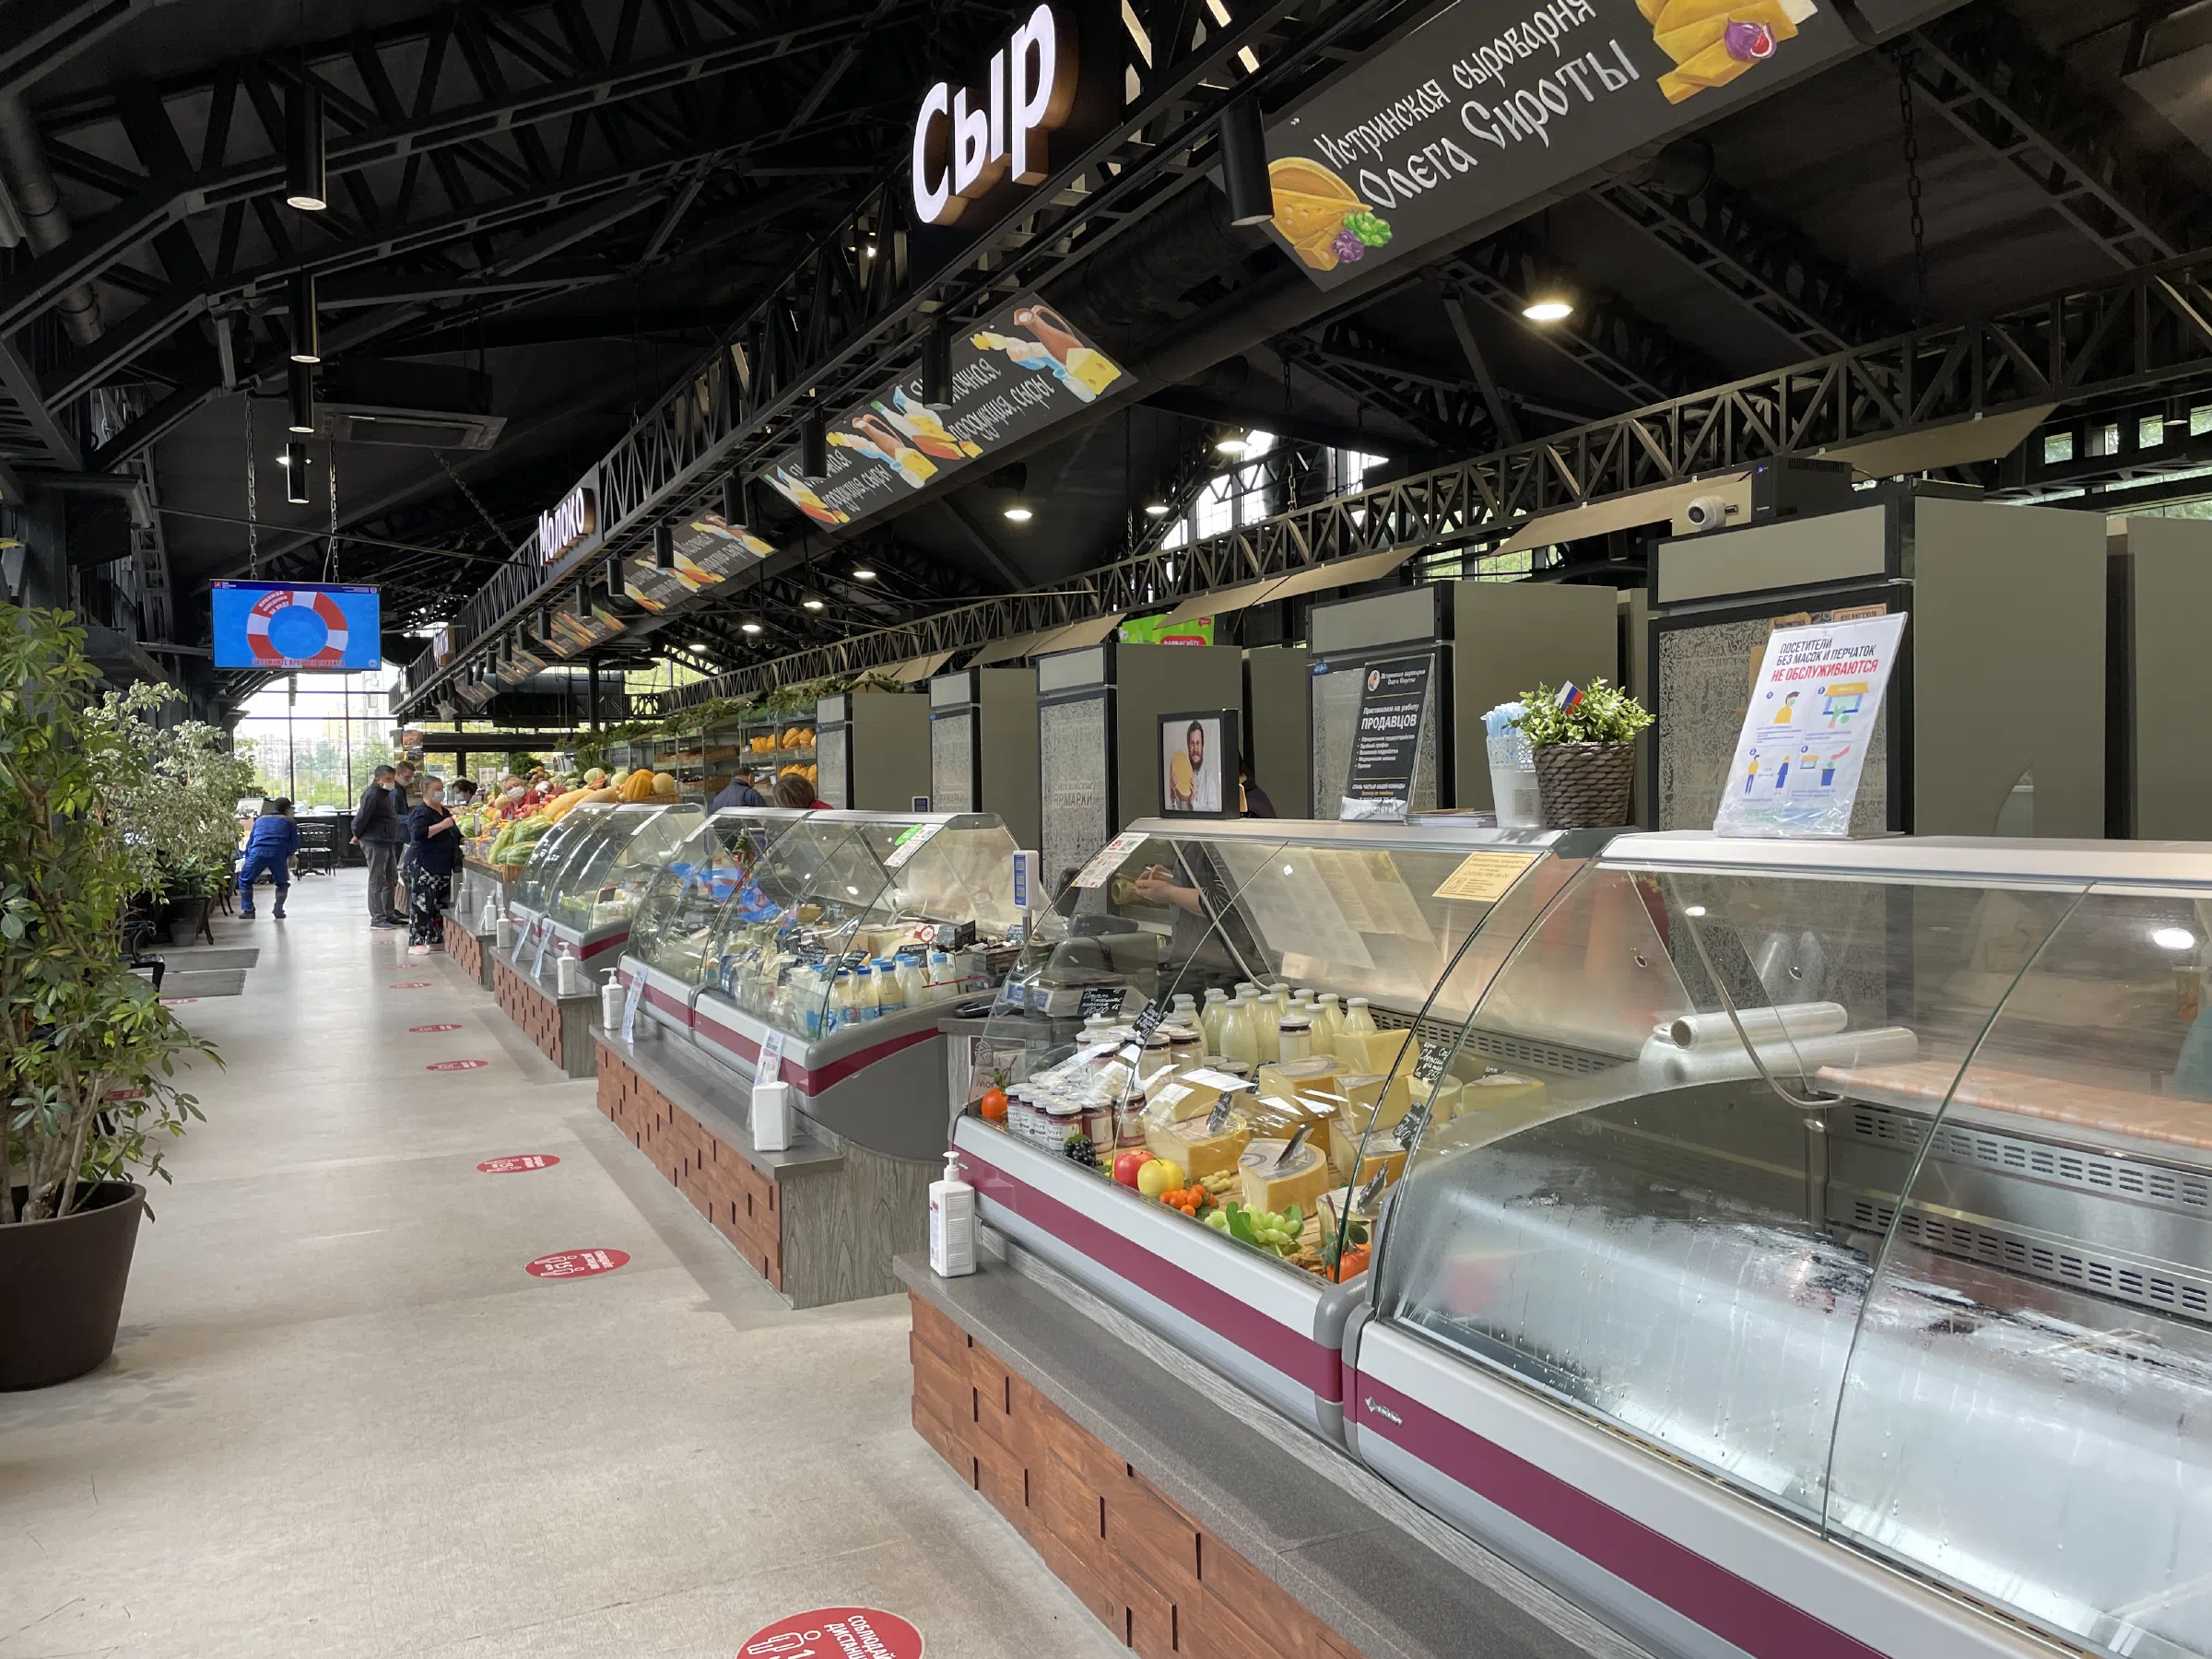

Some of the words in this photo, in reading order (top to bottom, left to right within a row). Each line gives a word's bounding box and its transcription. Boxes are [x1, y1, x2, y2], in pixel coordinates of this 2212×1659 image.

[1313, 78, 1452, 170] Истринская
[1452, 0, 1596, 89] сыроварня
[913, 4, 1055, 223] Сыр
[1359, 137, 1478, 209] Олега
[1460, 39, 1641, 149] Сироты
[539, 487, 585, 566] Молоко
[1776, 654, 1793, 665] БЕЗ
[1793, 651, 1823, 665] МАСОК
[1823, 649, 1830, 660] И
[1831, 645, 1877, 659] ПЕРЧАТОК
[1780, 638, 1833, 654] ПОСЕТИТЕЛИ
[1771, 669, 1786, 682] НЕ
[1785, 659, 1879, 681] ОБСЛУЖИВАЮТСЯ
[1361, 714, 1417, 731] ПРОДАВЦОВ
[1053, 793, 1092, 806] ЯРМАРКИ
[824, 1622, 867, 1659] ДИСТАНЦ
